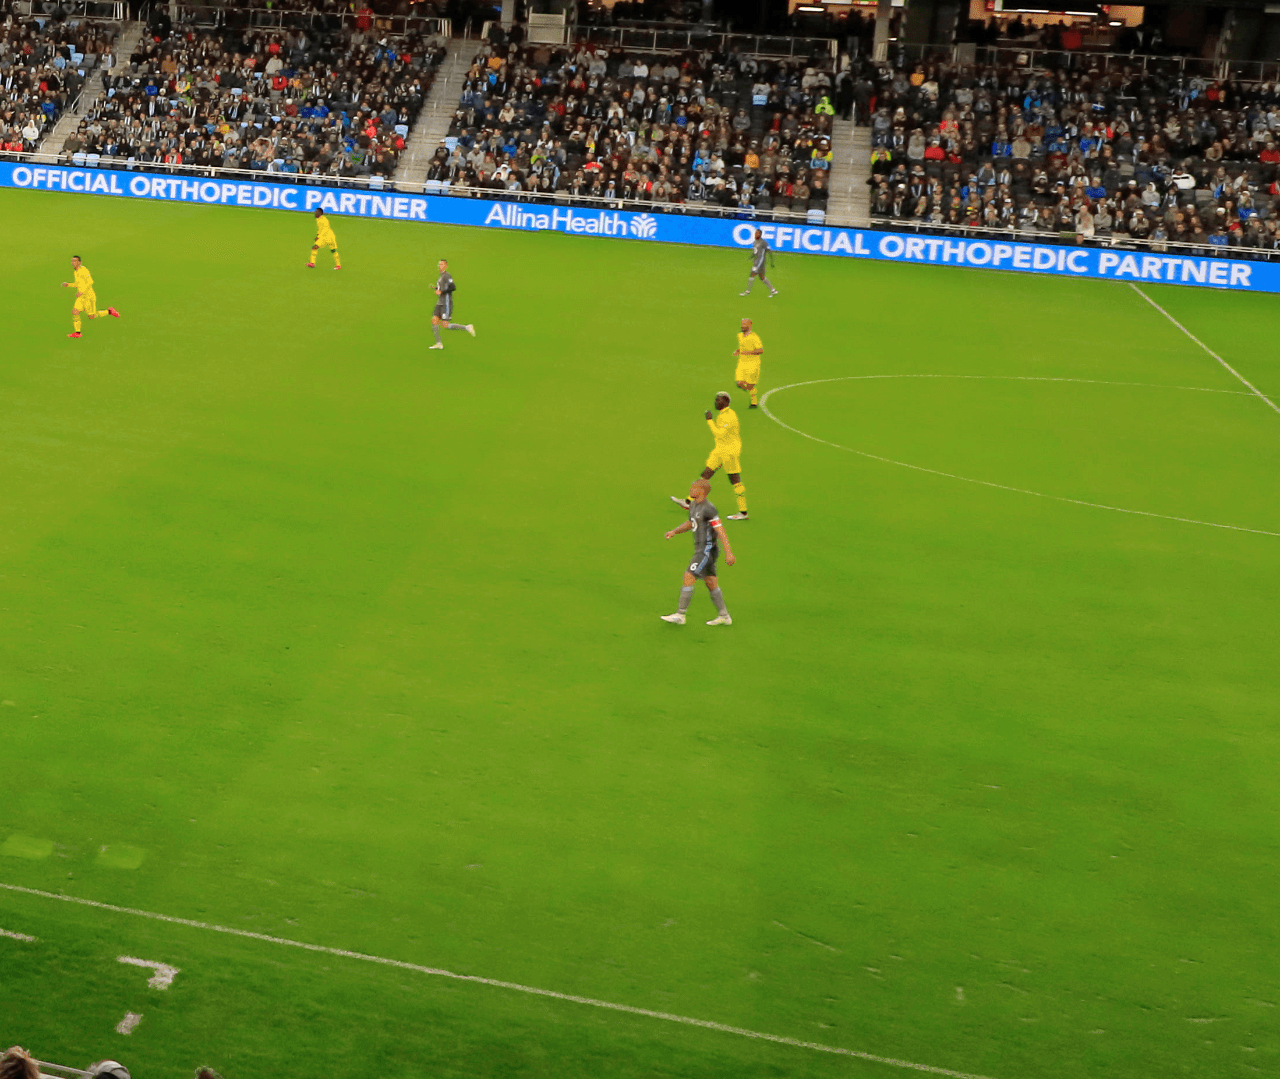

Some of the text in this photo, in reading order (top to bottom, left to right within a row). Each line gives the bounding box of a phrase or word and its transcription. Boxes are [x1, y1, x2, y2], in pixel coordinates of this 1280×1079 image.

[12, 166, 428, 220] OFFICIAL ORTHOPEDIC PARTNER
[732, 224, 1253, 287] OFFICIAL ORTHOPEDIC PARTNER
[689, 562, 699, 572] 6
